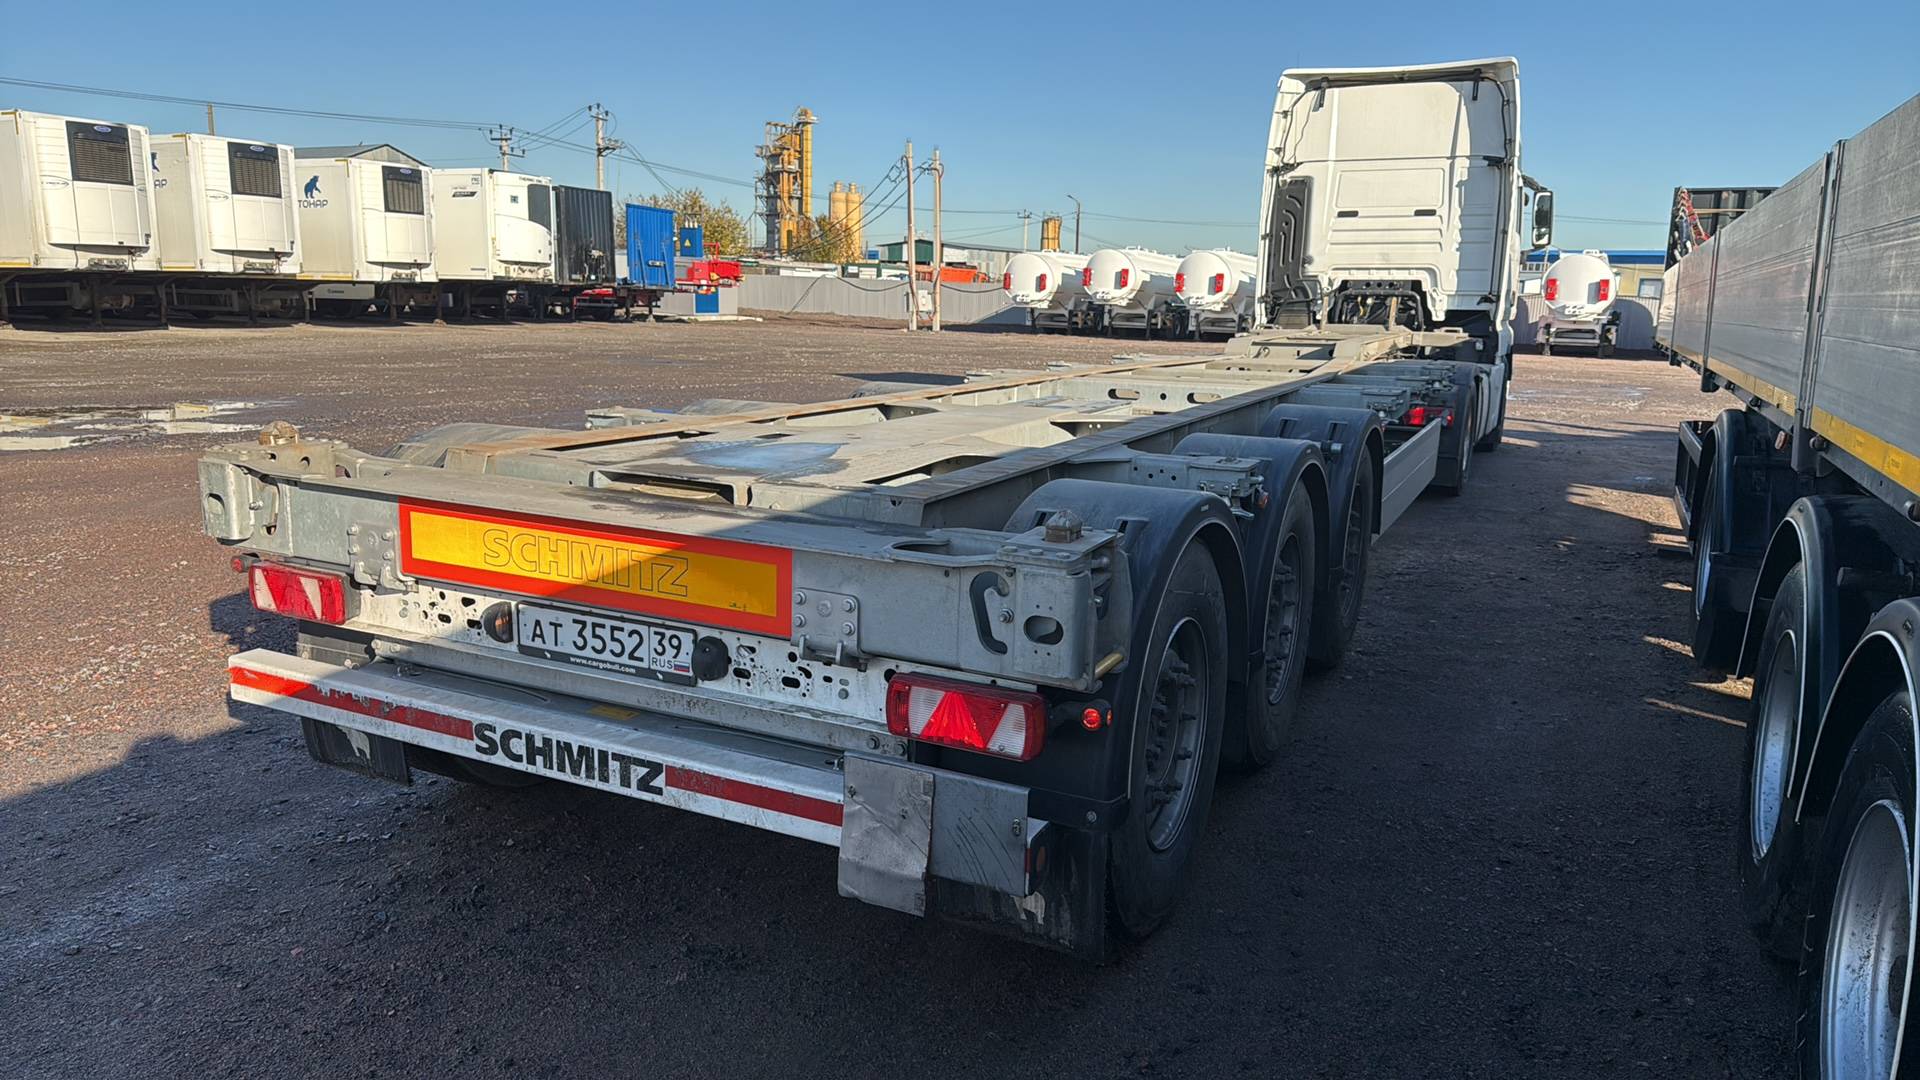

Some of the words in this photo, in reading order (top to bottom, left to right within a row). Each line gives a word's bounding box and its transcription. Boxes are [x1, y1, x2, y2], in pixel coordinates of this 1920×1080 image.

[483, 529, 688, 597] SCHMITZ
[572, 618, 644, 662] 3552
[653, 631, 682, 659] 39
[570, 656, 636, 674] www.cargobull.com
[651, 657, 673, 670] RUS
[475, 722, 663, 796] SCHMITZ
